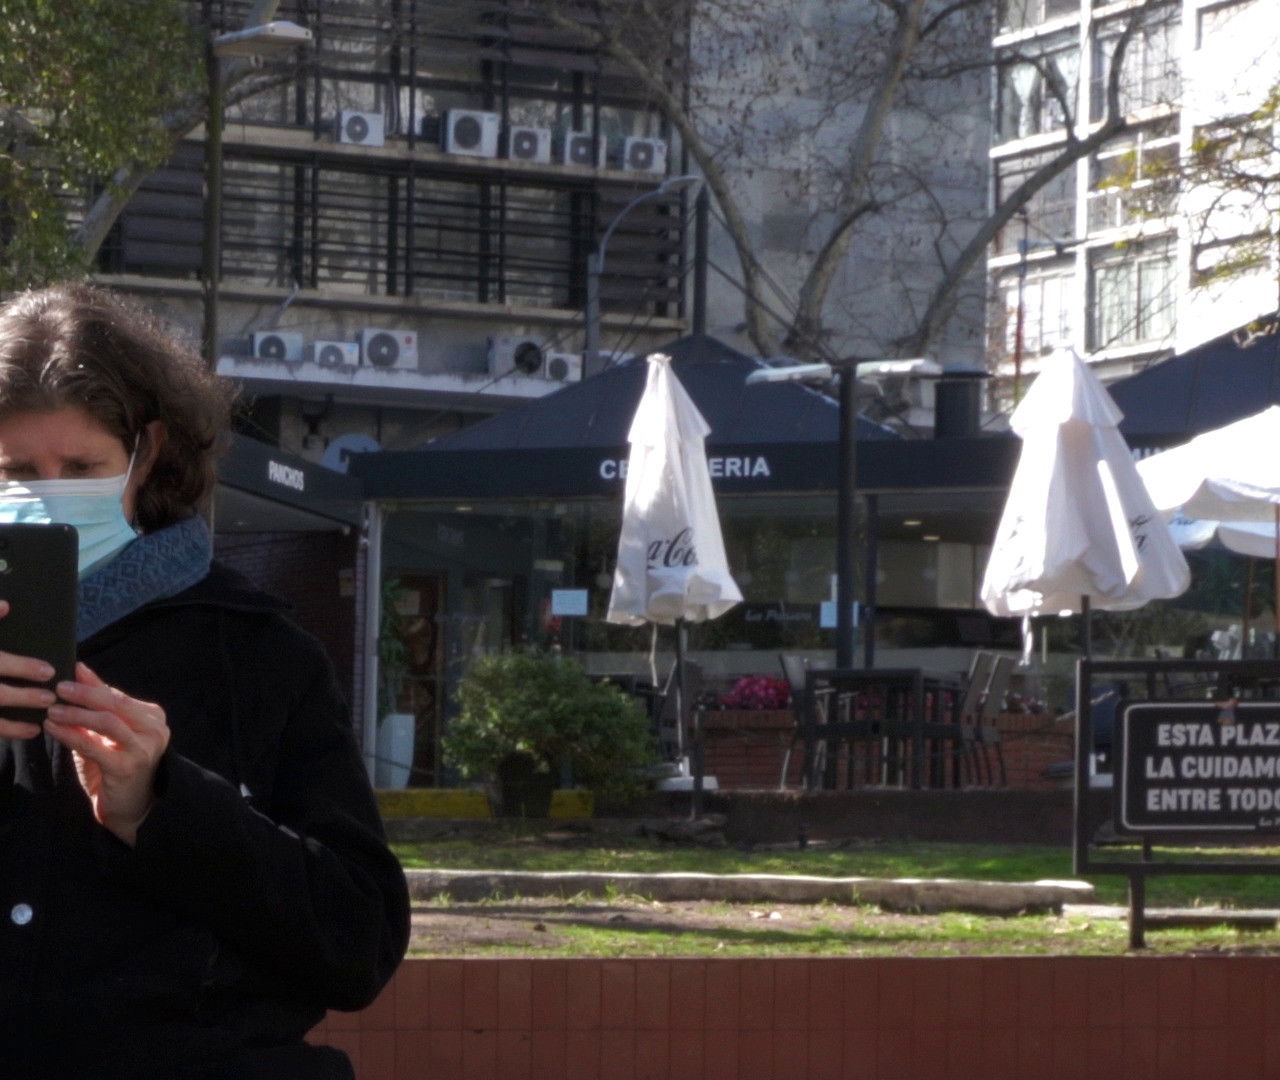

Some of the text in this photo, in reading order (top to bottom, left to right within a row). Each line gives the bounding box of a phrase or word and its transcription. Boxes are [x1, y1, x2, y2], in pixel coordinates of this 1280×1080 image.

[600, 456, 770, 479] CEERIA
[1157, 723, 1280, 747] ESTA PLAZ
[1145, 756, 1176, 778] LA
[1146, 788, 1222, 811] ENTRE
